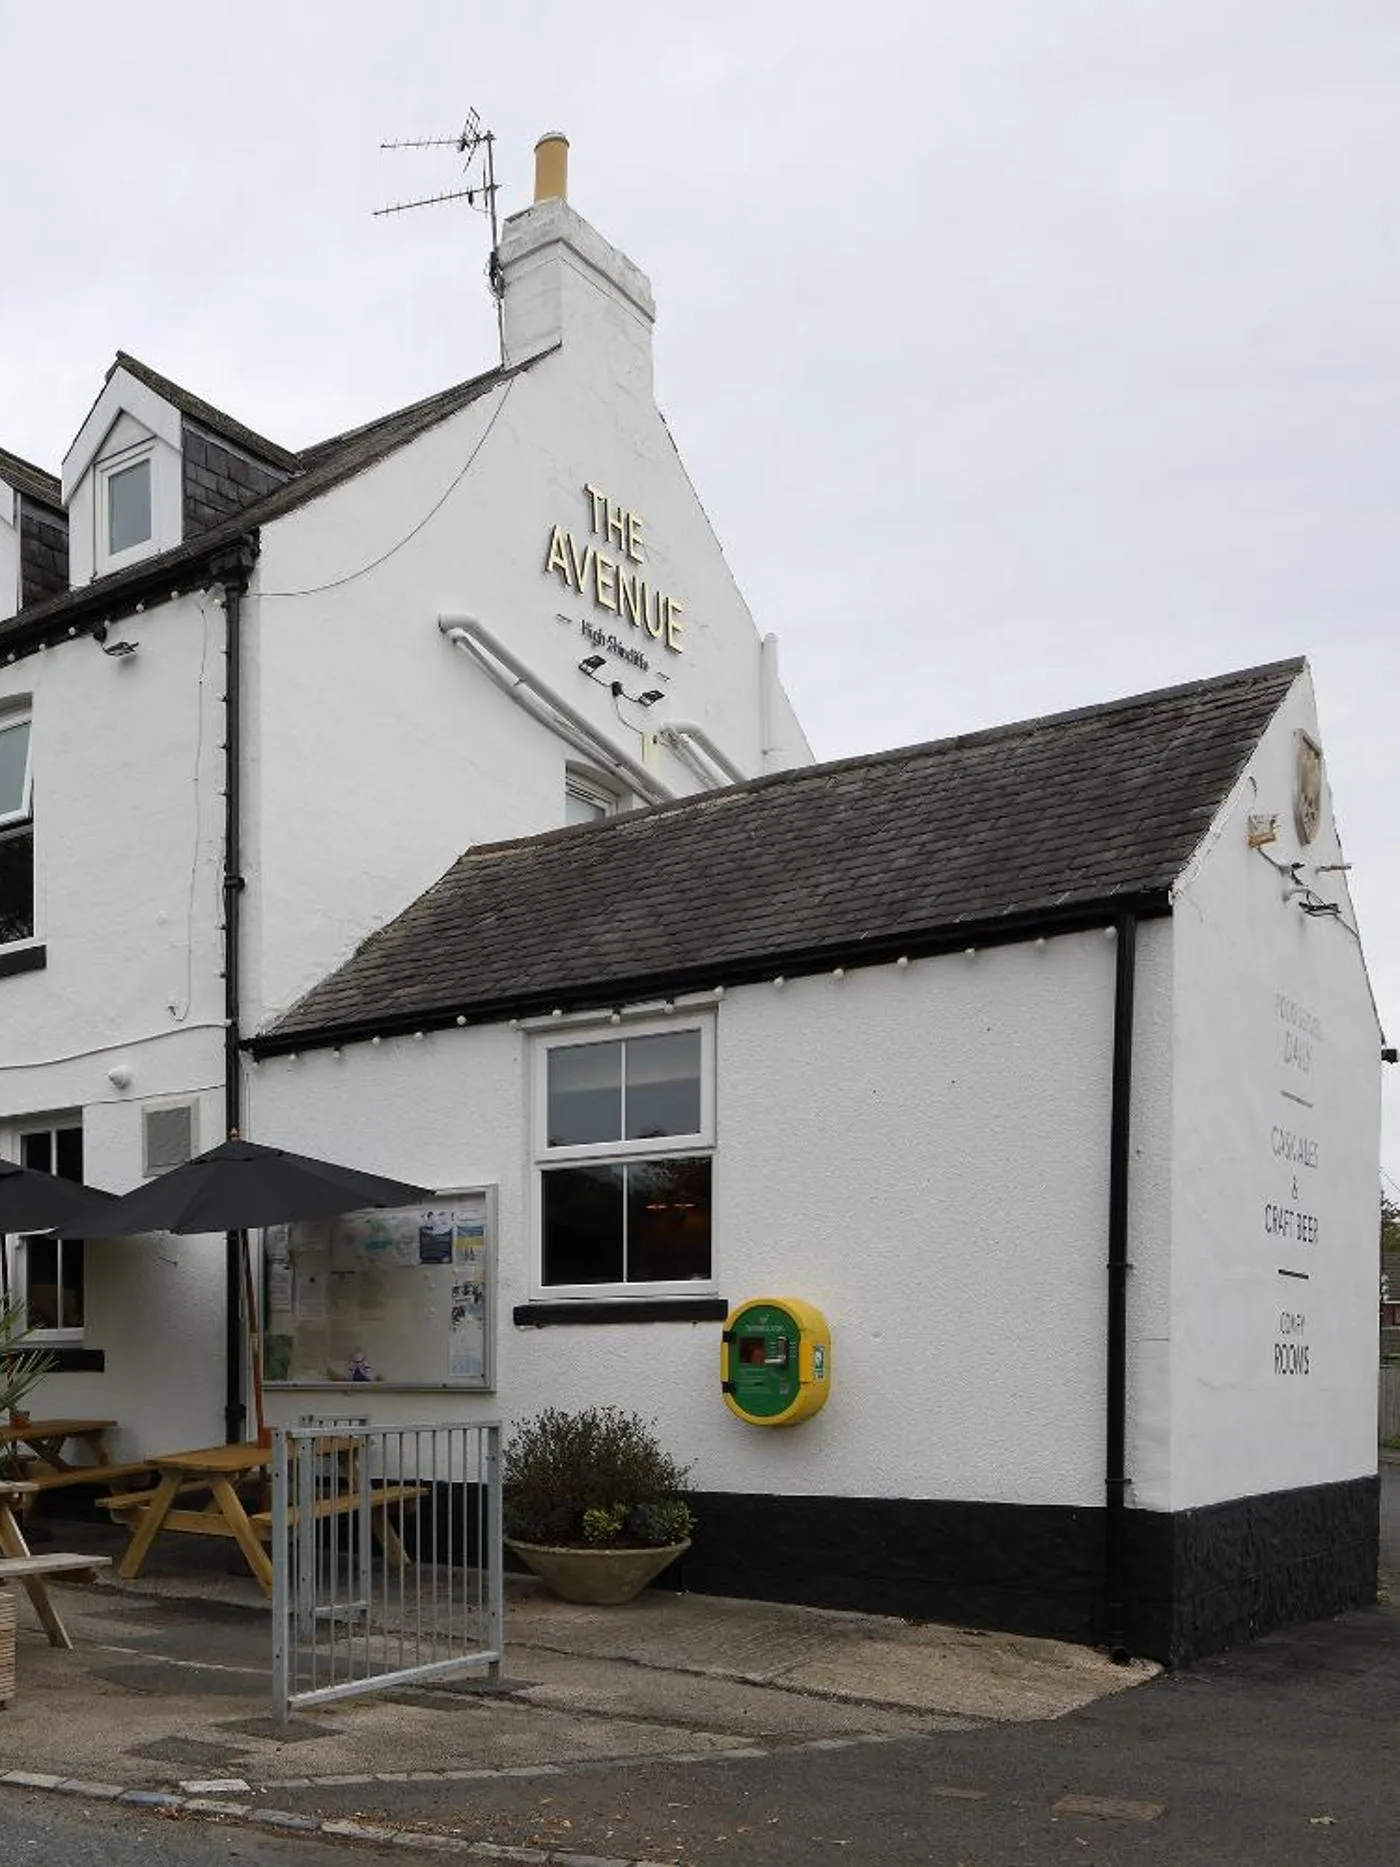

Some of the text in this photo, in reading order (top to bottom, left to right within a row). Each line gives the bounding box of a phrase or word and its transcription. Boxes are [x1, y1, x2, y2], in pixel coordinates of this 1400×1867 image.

[584, 483, 644, 564] THE
[544, 524, 683, 655] AVENUE
[582, 619, 605, 647] High
[1264, 1203, 1319, 1245] CRAFT BEER
[1274, 1343, 1309, 1375] ROOMS
